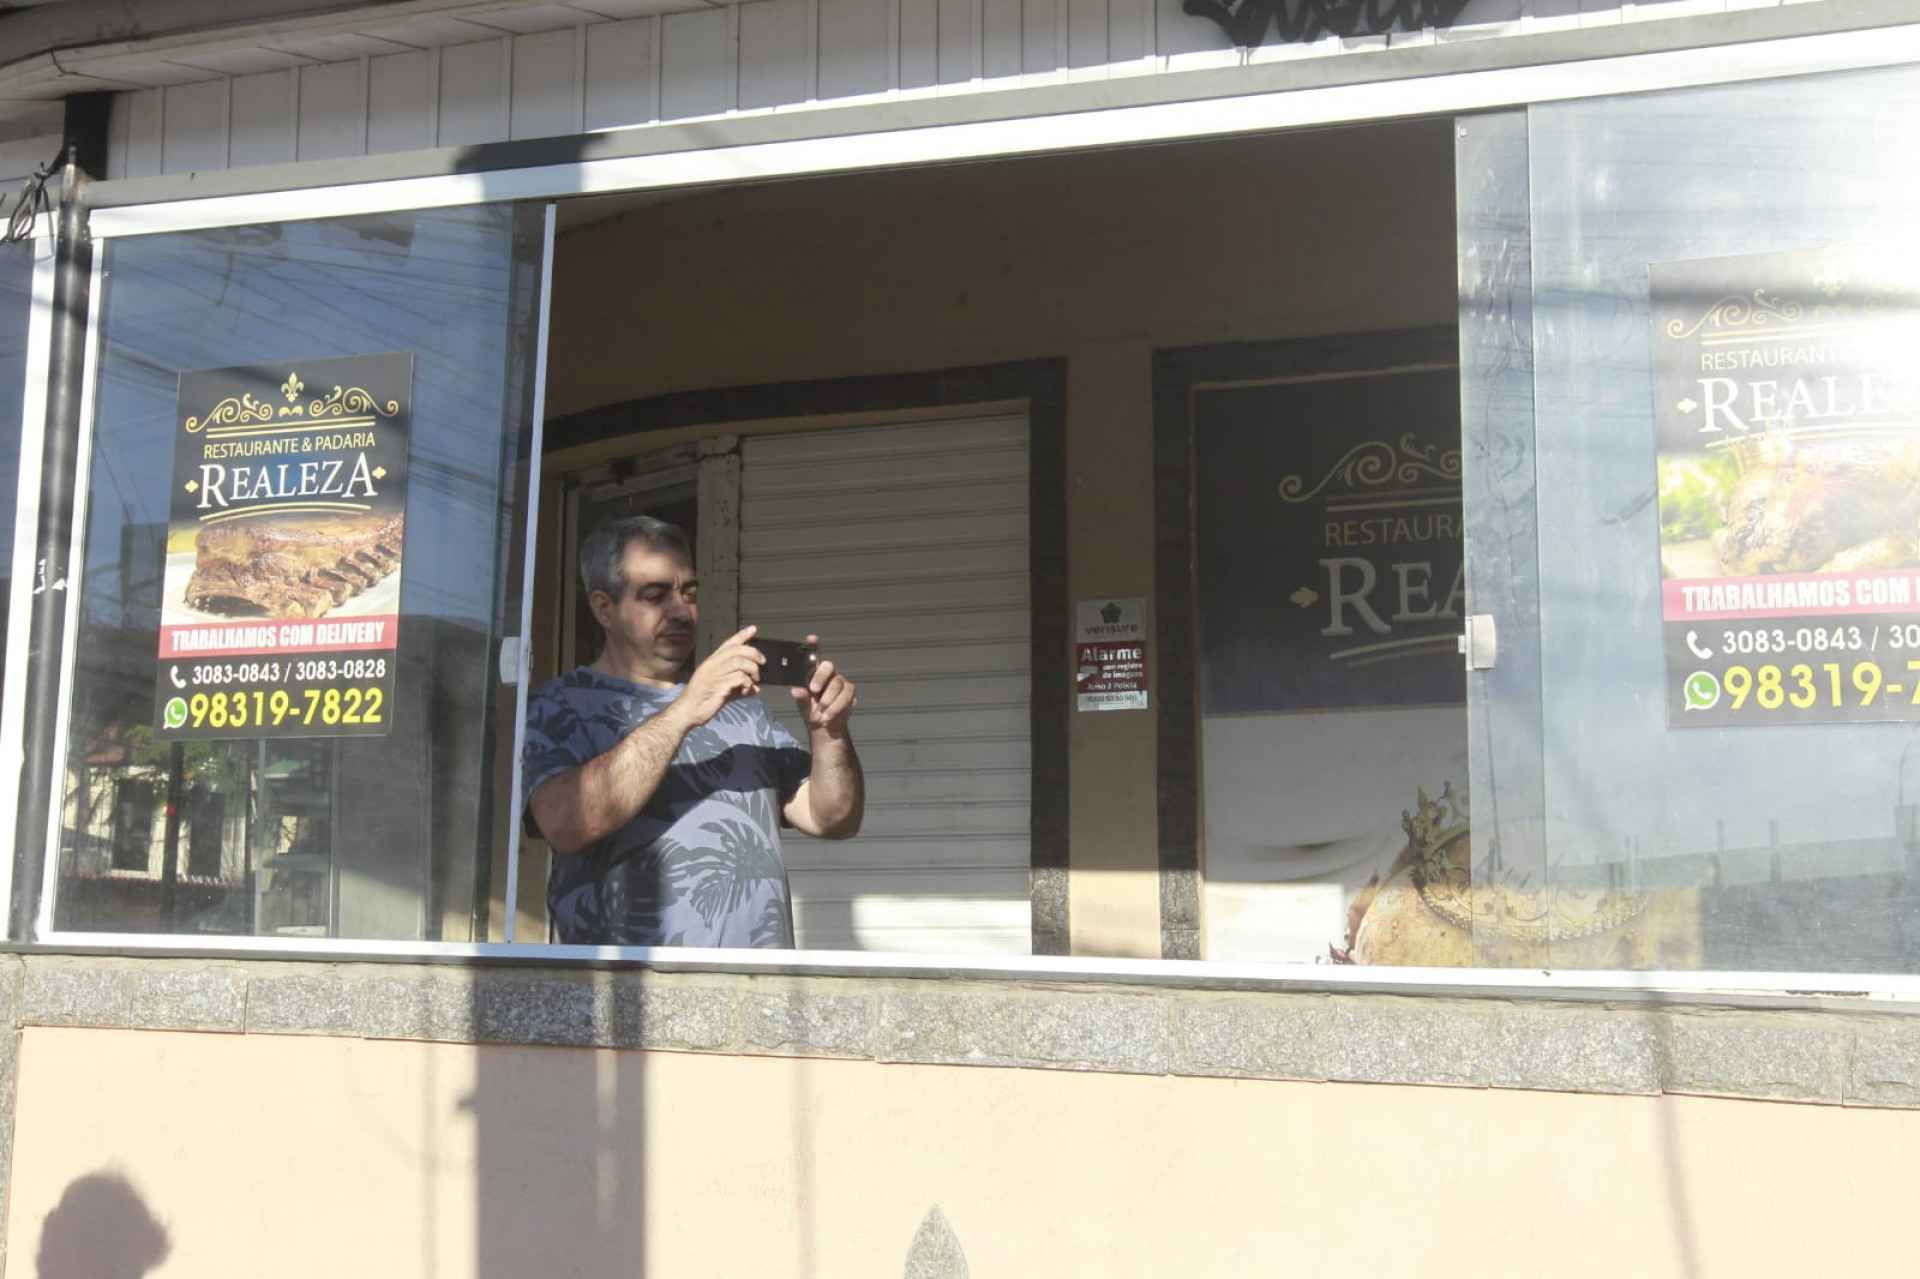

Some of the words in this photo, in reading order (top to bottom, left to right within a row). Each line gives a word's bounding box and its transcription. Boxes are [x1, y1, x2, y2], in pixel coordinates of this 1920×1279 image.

[1701, 343, 1854, 372] RESTAURANTE
[1696, 373, 1919, 433] REALE
[204, 437, 299, 459] RESTAURANTE
[302, 437, 312, 452] &
[315, 432, 376, 450] PADARIA
[196, 451, 379, 508] REALEZA
[1681, 579, 1851, 613] TRABALHAMOS
[1855, 576, 1911, 606] COM
[171, 625, 277, 652] TRABALHAMOS
[279, 624, 313, 647] COM
[316, 621, 385, 645] DELIVERY
[1722, 626, 1862, 654] 3083-0843
[1082, 647, 1142, 661] Alarme
[192, 662, 280, 685] 3083-0843
[295, 658, 386, 681] 3083-0828
[190, 686, 383, 728] 98319-7822
